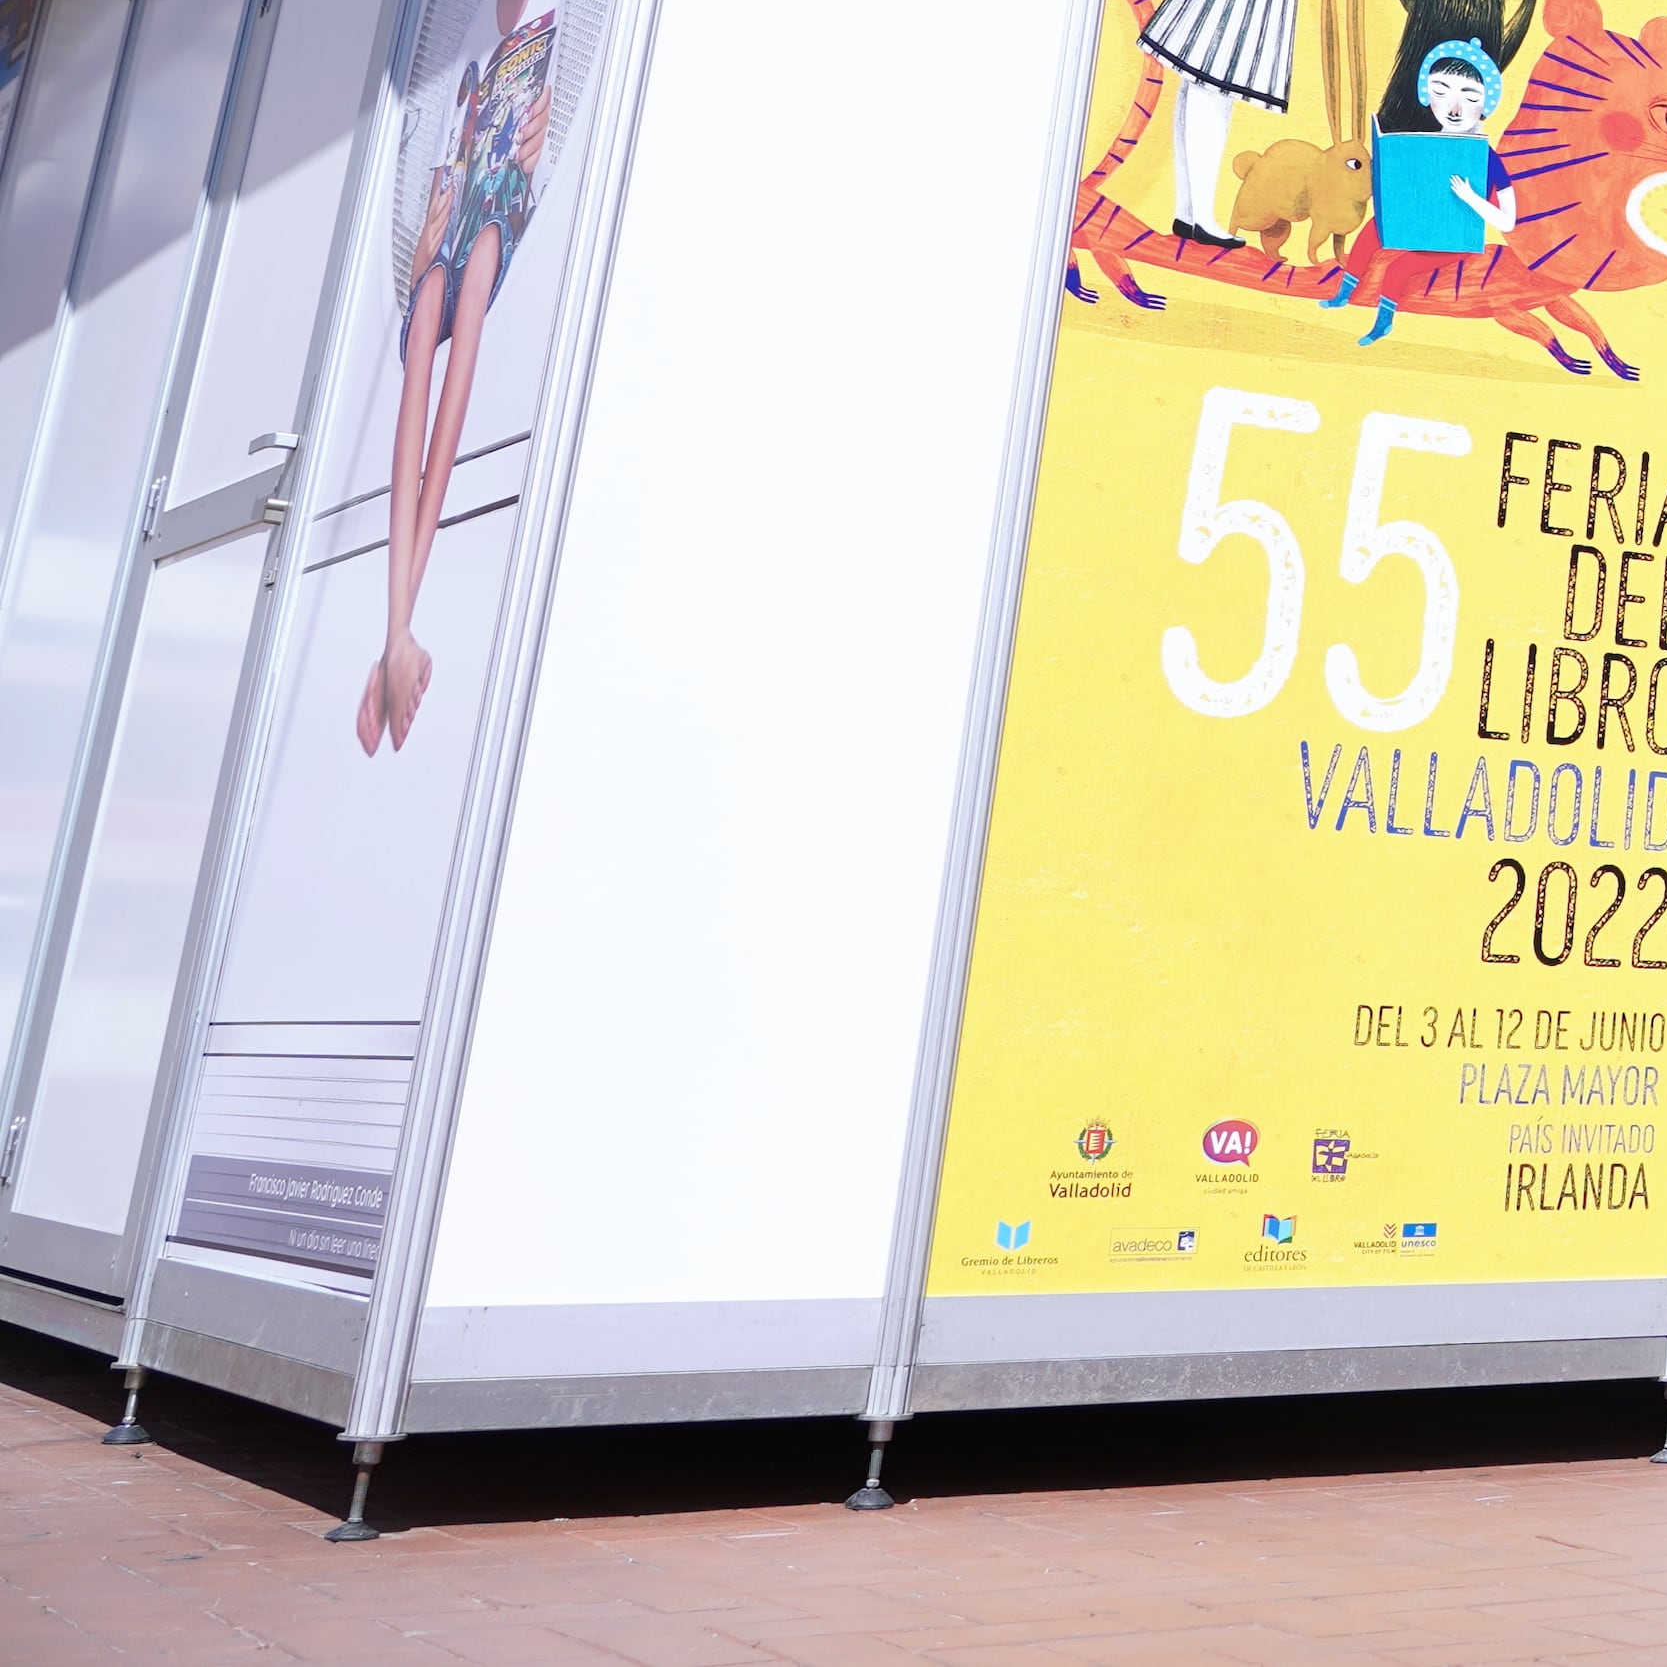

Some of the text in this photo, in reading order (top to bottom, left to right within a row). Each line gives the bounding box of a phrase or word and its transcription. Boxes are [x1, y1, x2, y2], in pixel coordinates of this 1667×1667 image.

[1161, 387, 1473, 732] 55
[1354, 1005, 1666, 1052] DEL 3 AL 12 DE JUNIO
[1459, 1063, 1659, 1106] PLAZA MAYOR
[1210, 1131, 1251, 1154] VA!
[1509, 1116, 1655, 1154] PAÍS INVITADO
[1050, 1170, 1133, 1180] Ayuntamiento de
[1195, 1174, 1259, 1183] VALLADOLID
[249, 1173, 383, 1209] Francisco Javier Rodríguez Conde
[1049, 1182, 1132, 1199] Valladolid
[1504, 1162, 1649, 1212] IRLANDA
[1112, 1238, 1172, 1252] avadeco
[1244, 1244, 1307, 1262] editores
[1353, 1239, 1437, 1249] VALLADOLID unesco
[961, 1256, 1059, 1267] Gremio de Libreros
